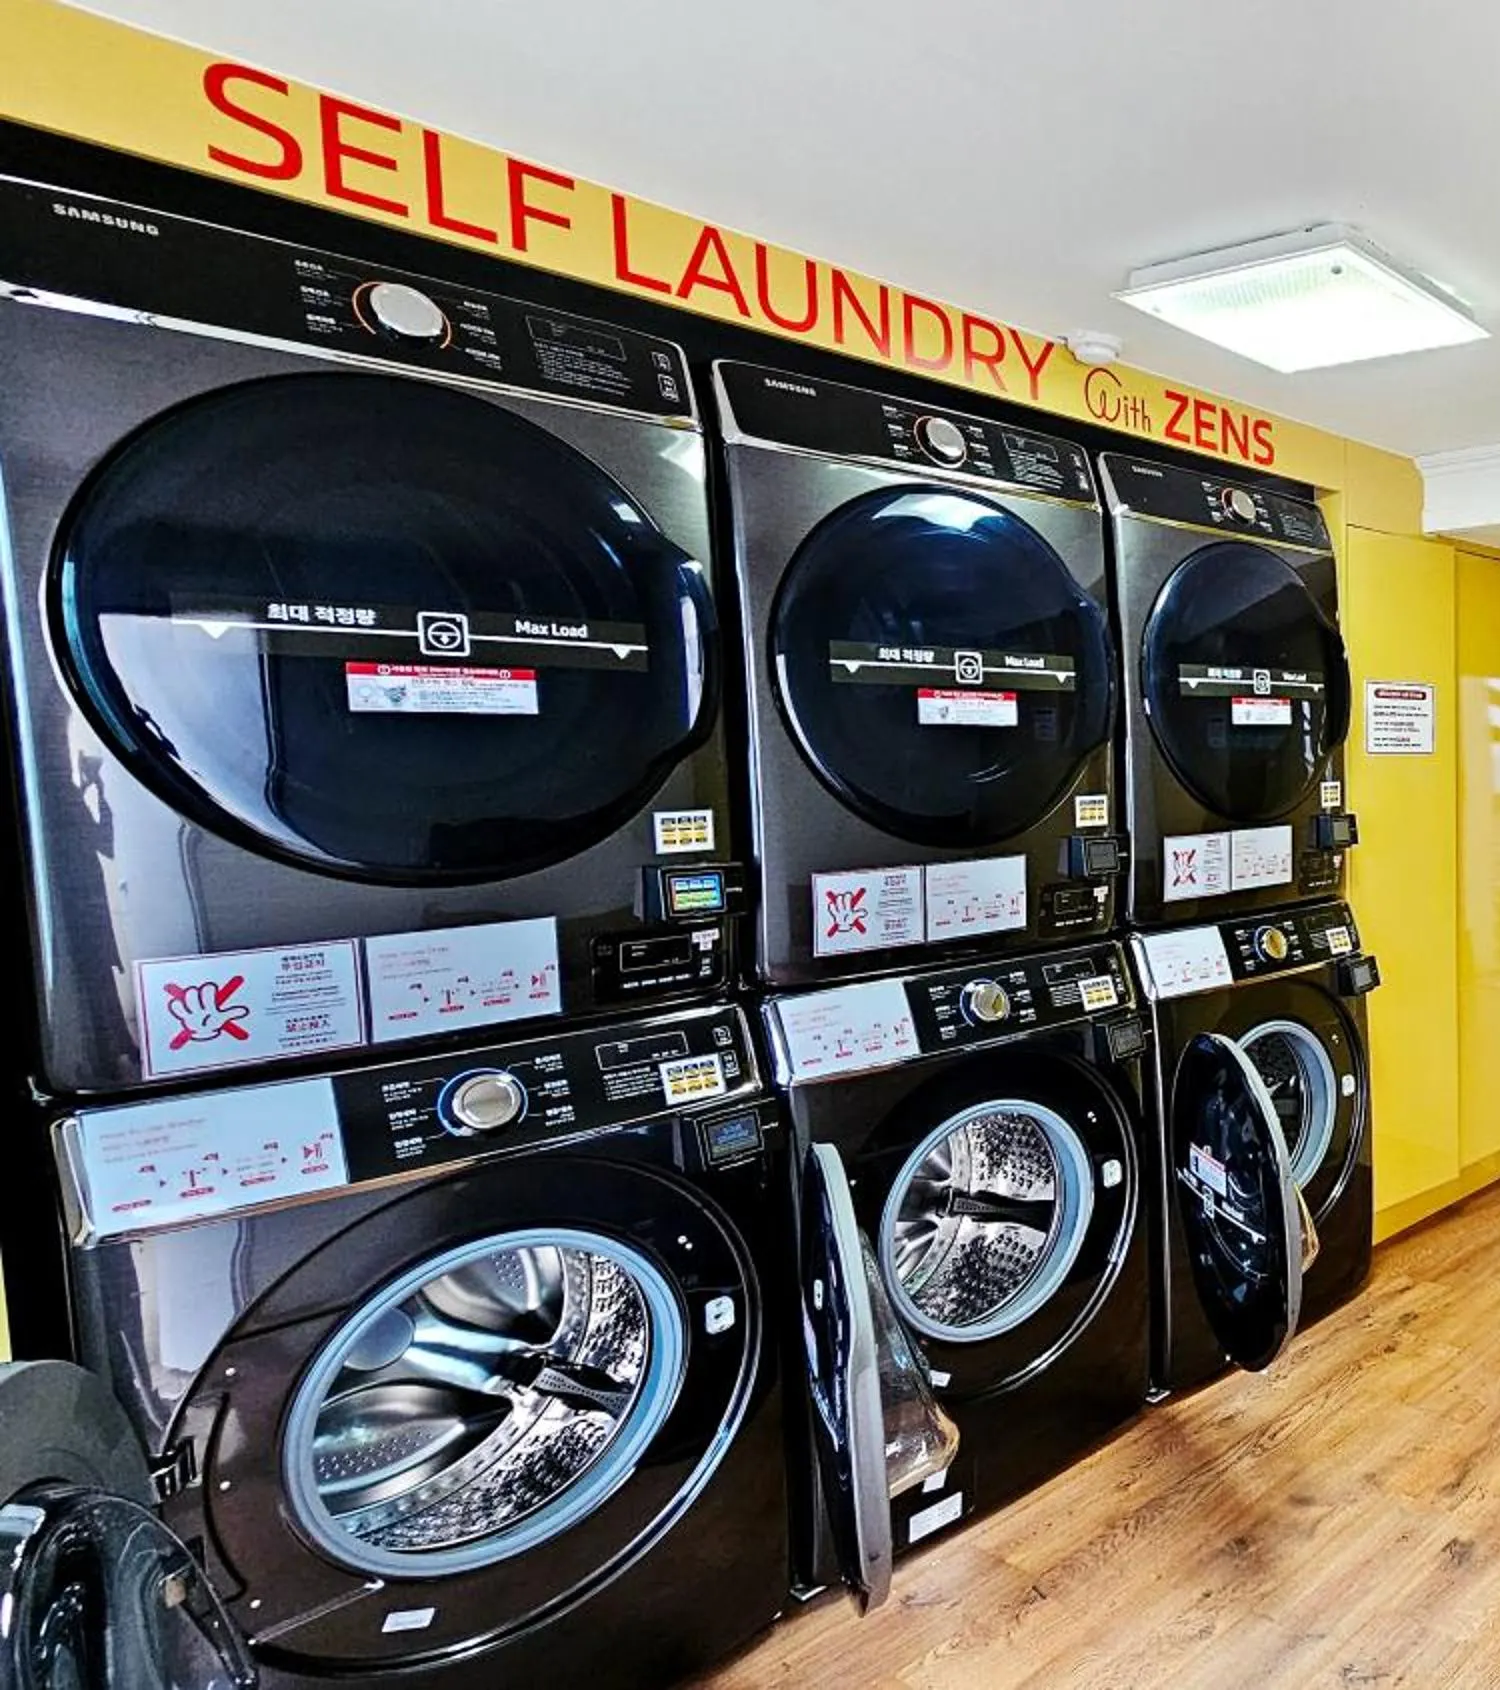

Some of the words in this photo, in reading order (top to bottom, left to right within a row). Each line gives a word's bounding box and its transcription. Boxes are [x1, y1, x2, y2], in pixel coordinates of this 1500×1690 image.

[53, 203, 160, 237] SAMSUNG
[203, 63, 575, 252] SELF
[611, 194, 1055, 400] LAUNDRY
[1165, 390, 1275, 466] ZENS
[267, 603, 309, 623] 최대
[515, 619, 548, 637] Max
[551, 622, 589, 639] Load
